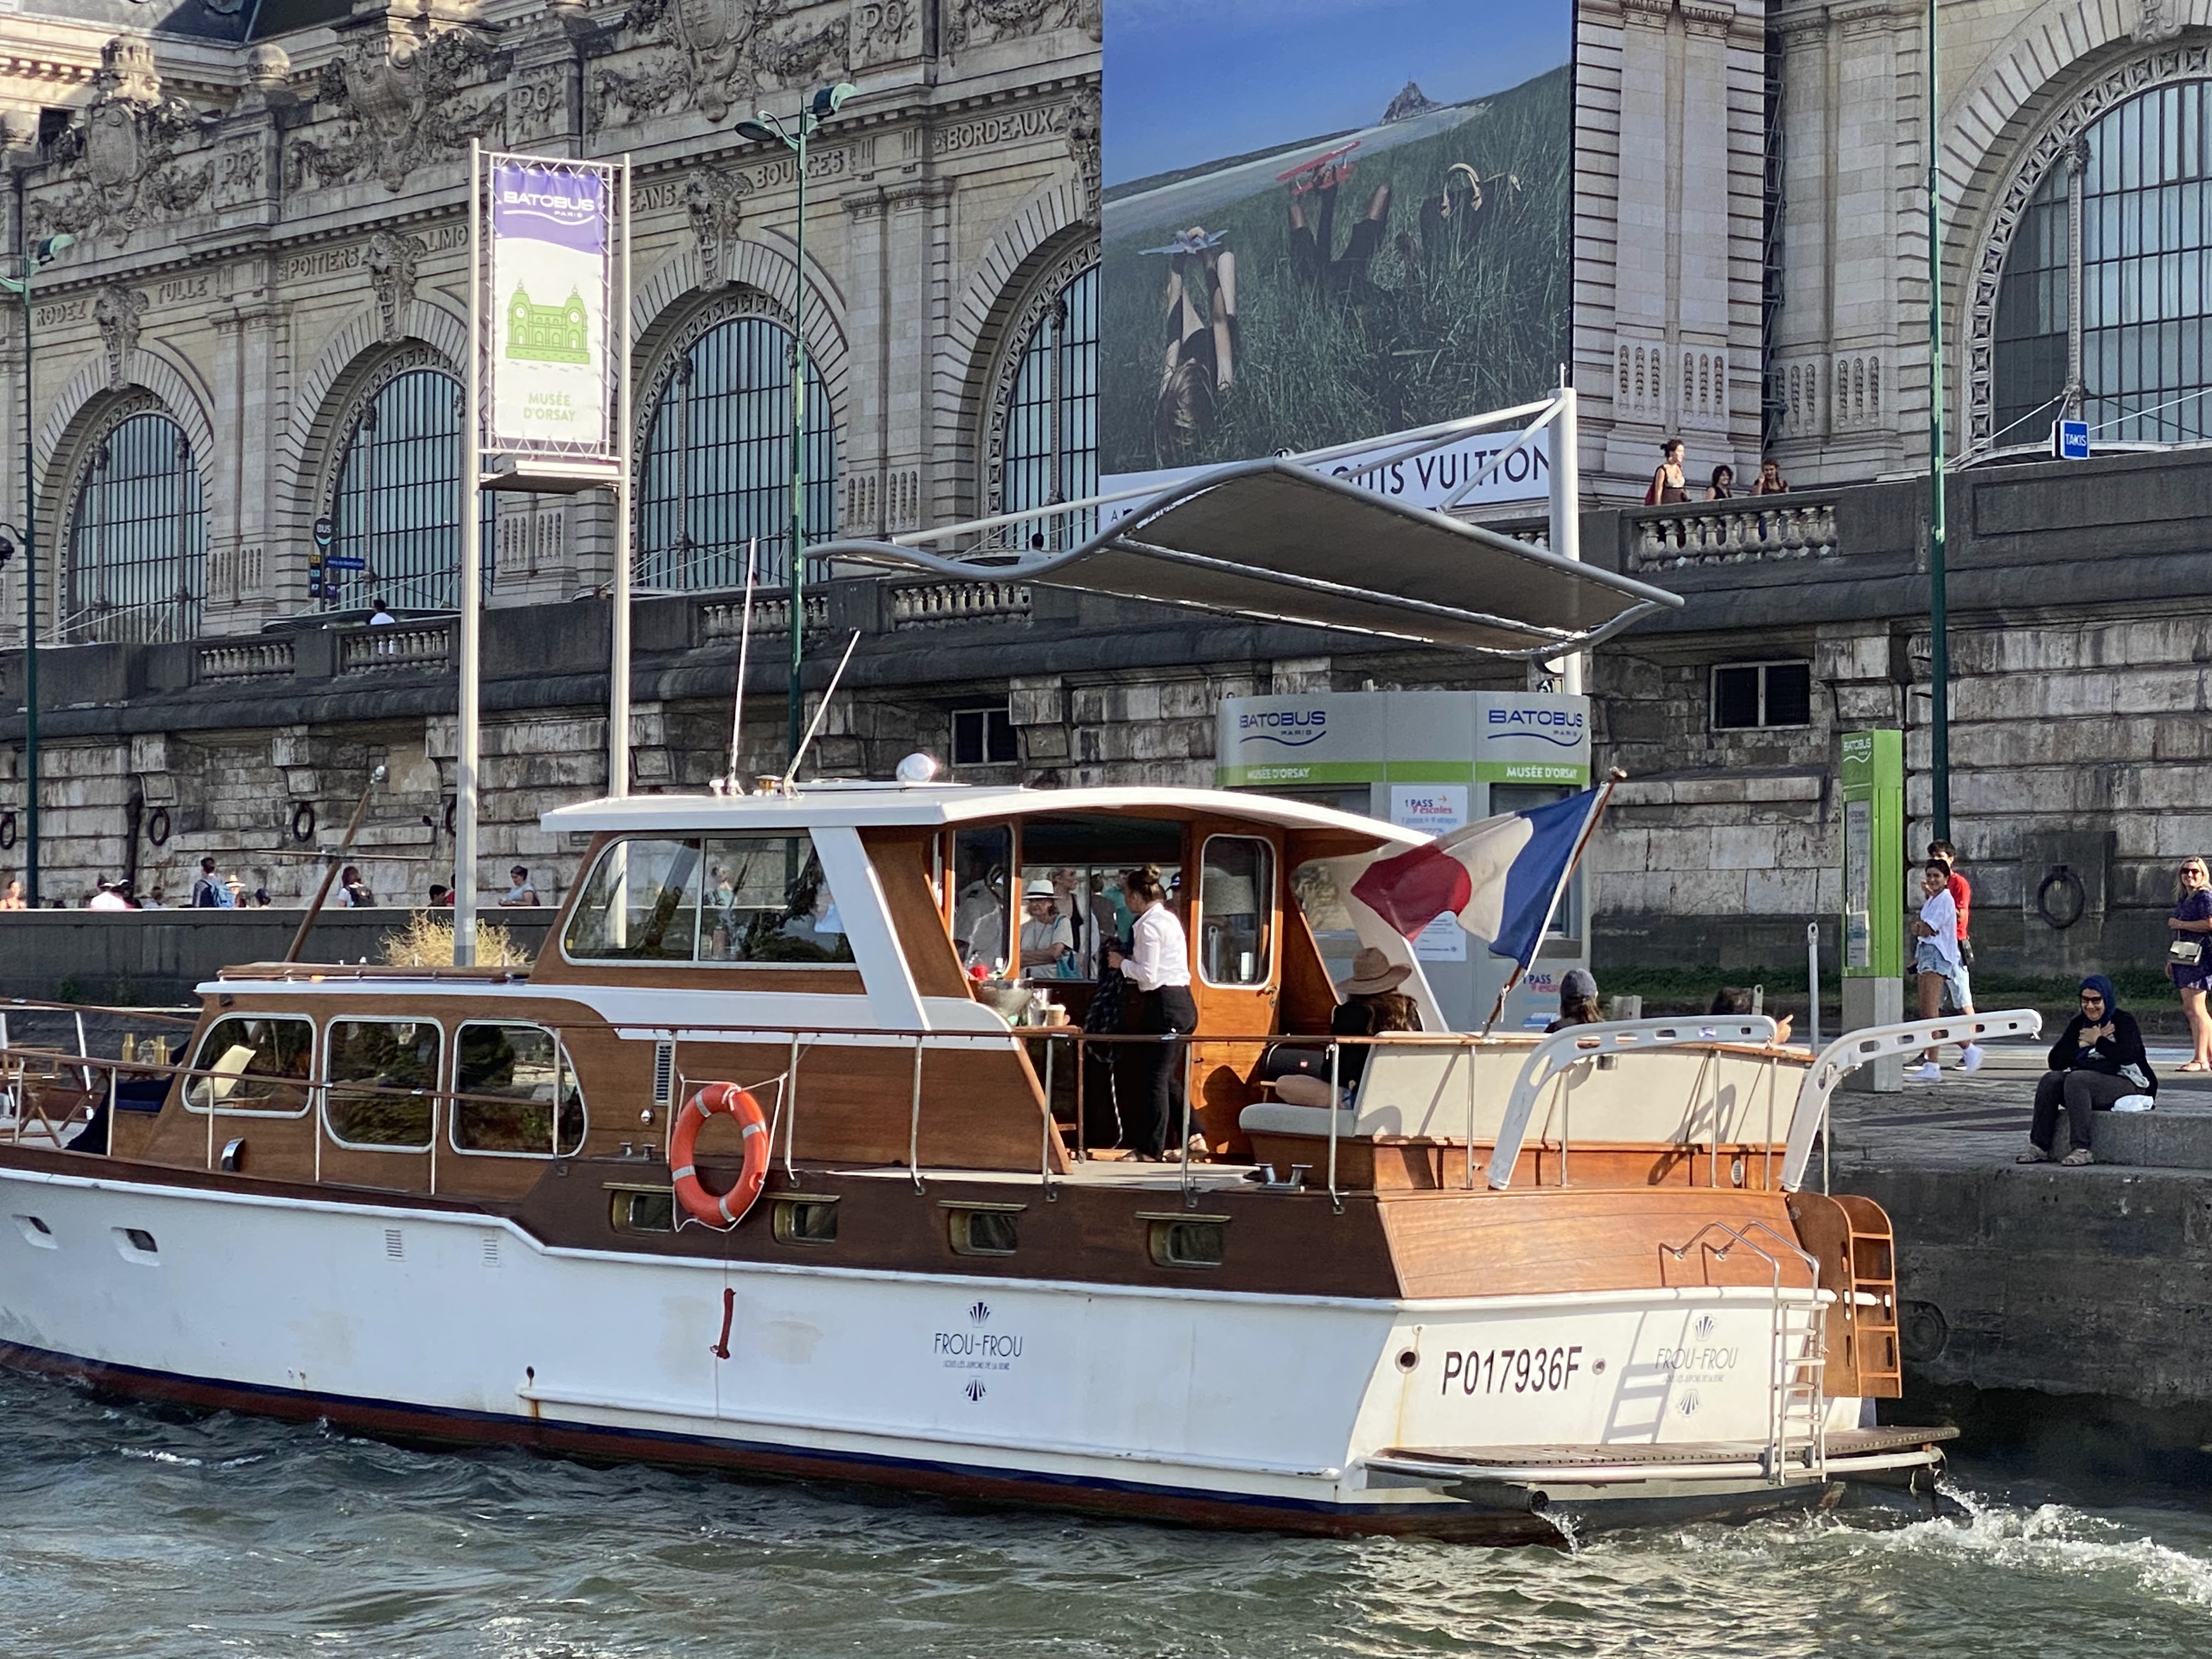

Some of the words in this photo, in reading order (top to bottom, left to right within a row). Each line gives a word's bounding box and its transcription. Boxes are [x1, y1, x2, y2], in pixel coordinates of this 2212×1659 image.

[947, 108, 1055, 151] BORDEAUX
[503, 190, 595, 212] BATOBUS
[287, 246, 359, 279] POITIERS
[528, 391, 571, 407] MUSÉE
[523, 407, 577, 422] D'ORSAY
[317, 524, 331, 534] BUS
[1239, 711, 1326, 728] BATOBUS
[1489, 710, 1583, 727] BATOBUS
[1247, 766, 1272, 780] MUSÉE
[1272, 768, 1310, 778] D'ORSAY
[1506, 765, 1543, 778] MUSÉE
[1545, 766, 1578, 778] D'ORSAY
[1411, 799, 1433, 808] PASS
[1529, 974, 1551, 984] PASS
[934, 1333, 1023, 1357] FROU-FROU
[1655, 1347, 1739, 1369] FROU-FROU
[1442, 1346, 1583, 1396] P017936F
